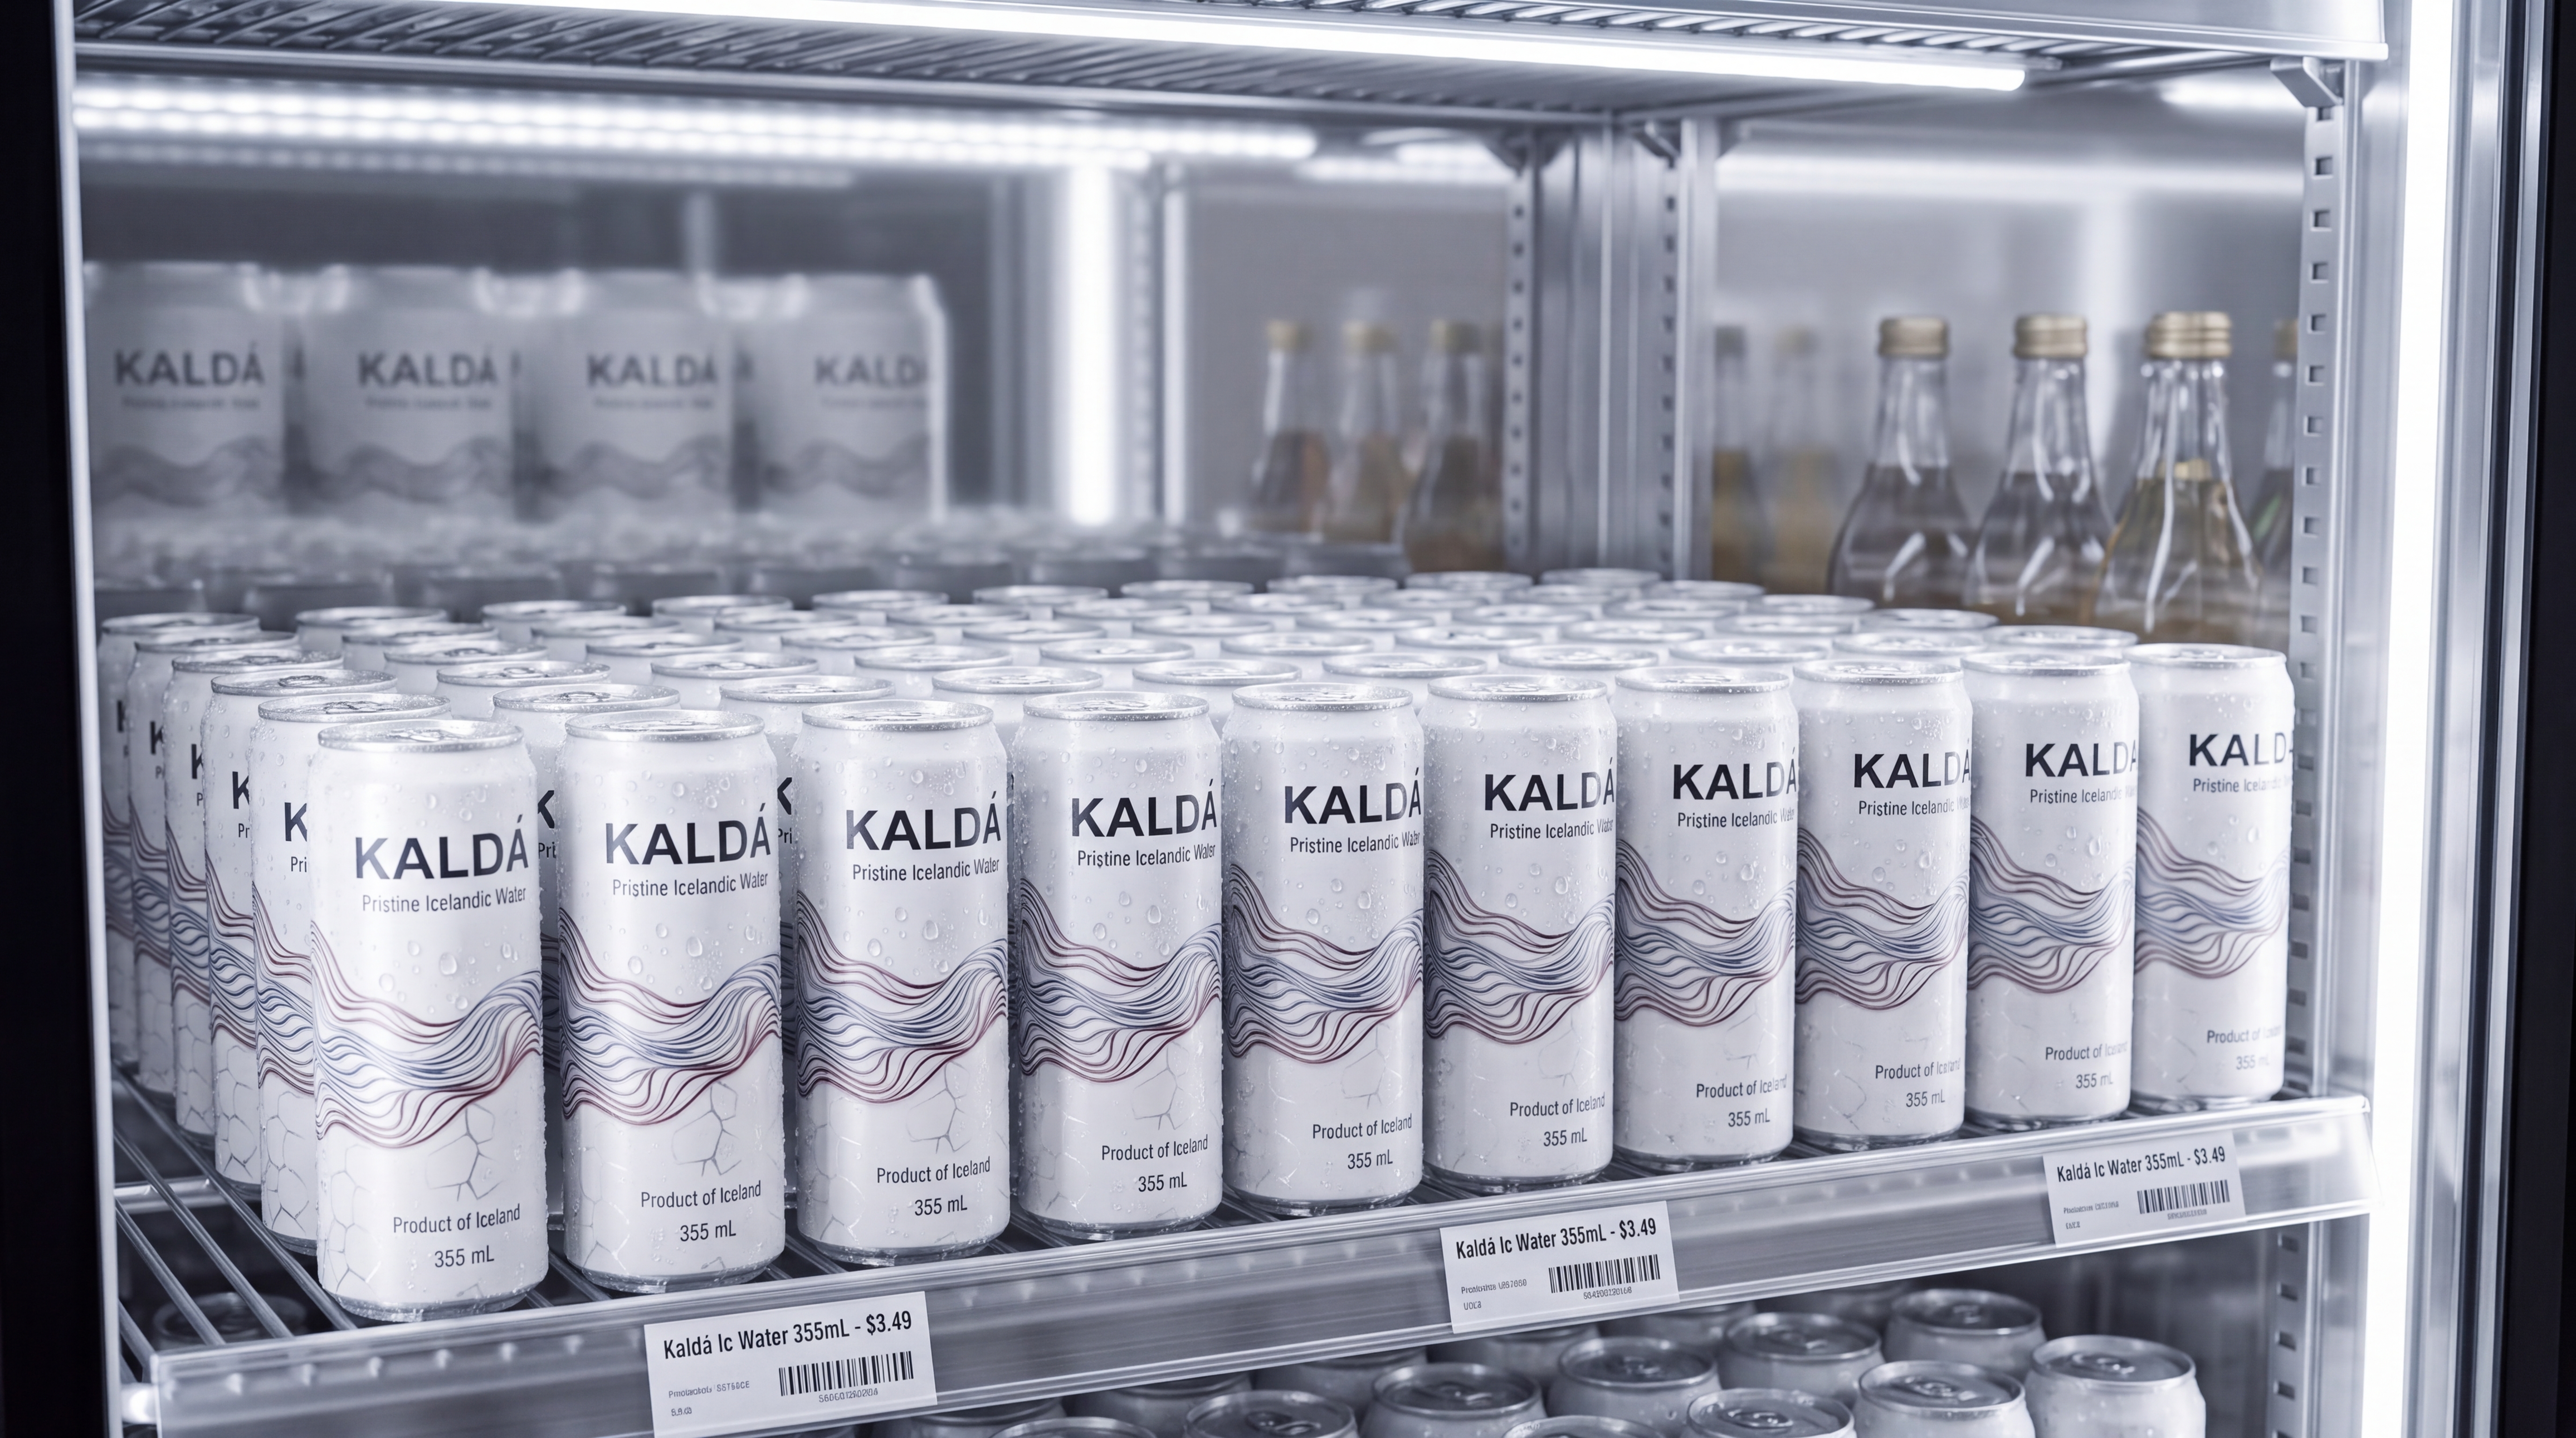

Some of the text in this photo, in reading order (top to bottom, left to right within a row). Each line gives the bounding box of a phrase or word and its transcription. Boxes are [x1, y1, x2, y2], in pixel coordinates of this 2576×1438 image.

[2189, 733, 2293, 766] KALD
[1485, 756, 1614, 812] KALDÁ
[1673, 747, 1797, 800] KALDÁ
[1285, 767, 1421, 824] KALDÁ
[2030, 789, 2077, 804] Pristine
[2193, 778, 2239, 793] Pristine
[1072, 778, 1217, 837] KALDÁ
[1859, 800, 1907, 816] Pristine
[847, 791, 1001, 850] KALDÁ
[1491, 823, 1541, 839] Pristine
[1546, 821, 1594, 838] Icelandic
[1678, 812, 1727, 829] Pristine
[606, 803, 770, 865] KALDÁ
[1291, 837, 1342, 854] Pristine
[1348, 834, 1398, 852] Icelandic
[356, 814, 528, 879] KALDÁ
[1078, 850, 1130, 868] Pristine
[1136, 846, 1190, 866] Icelandic
[853, 857, 999, 881] Pristine Icelandic Water
[613, 871, 768, 897] Pristine Icelandic Water
[363, 887, 526, 912] Pristine Icelandic Water
[2207, 1030, 2249, 1043] Product
[2045, 1047, 2090, 1061] Product
[1875, 1064, 1921, 1079] Product
[1924, 1062, 1934, 1077] of
[2076, 1073, 2097, 1089] 355
[1697, 1082, 1743, 1098] Product
[1746, 1080, 1757, 1095] of
[1906, 1089, 1946, 1108] 355 mL
[1510, 1093, 1605, 1117] Product of Iceland
[1313, 1113, 1412, 1139] Product of Iceland
[1728, 1108, 1770, 1127] 355 mL
[1102, 1134, 1208, 1160] Product of Iceland
[1544, 1128, 1588, 1147] 355 mL
[878, 1156, 990, 1183] Product of Iceland
[1348, 1149, 1393, 1169] 355 mL
[2057, 1163, 2091, 1182] Kaldá
[2094, 1162, 2105, 1177] Ic
[2107, 1159, 2142, 1175] Water
[2145, 1152, 2184, 1171] 355mL
[2194, 1146, 2225, 1166] $3.49
[1138, 1172, 1187, 1192] 355 mL
[642, 1180, 761, 1208] Product of Iceland
[915, 1195, 967, 1216] 355 mL
[394, 1203, 520, 1233] Product of Iceland
[680, 1220, 736, 1242] 355 mL
[1456, 1237, 1496, 1259] Kaldá
[1500, 1236, 1512, 1254] Ic
[1515, 1233, 1556, 1251] Water
[1560, 1224, 1607, 1246] 355mL
[1619, 1218, 1656, 1240] $3.49
[435, 1245, 494, 1268] 355 mL
[664, 1335, 712, 1359] Kaldá
[718, 1334, 733, 1352] Ic
[738, 1329, 788, 1350] Water
[793, 1319, 849, 1343] 355mL
[866, 1311, 911, 1335] $3.49
